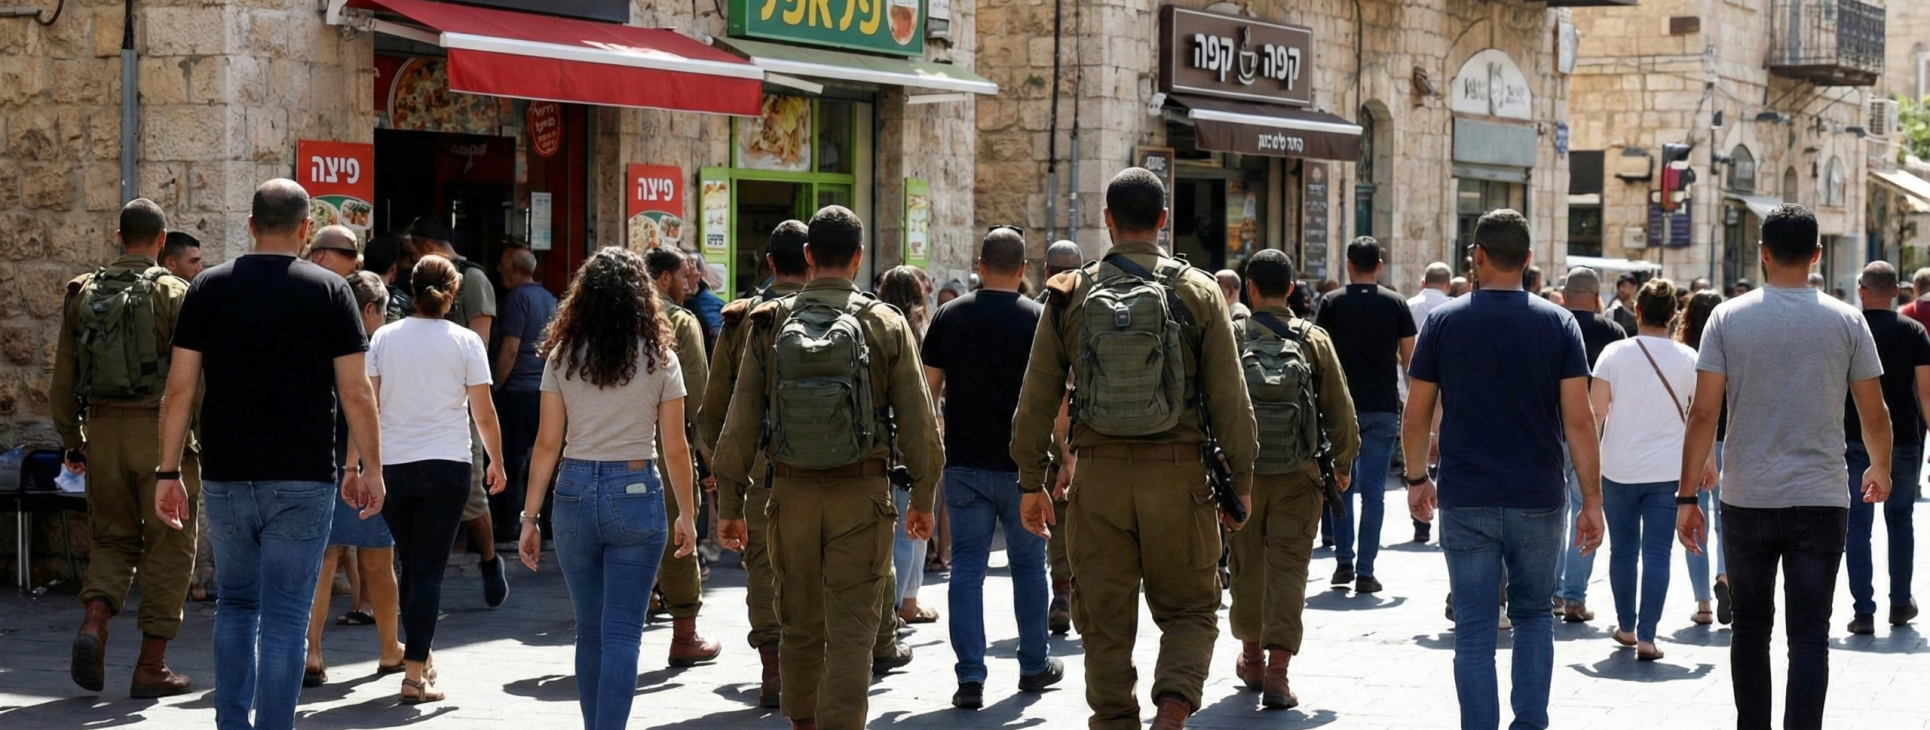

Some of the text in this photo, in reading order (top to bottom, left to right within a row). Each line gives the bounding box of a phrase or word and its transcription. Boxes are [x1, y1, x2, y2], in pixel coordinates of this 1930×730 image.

[1194, 33, 1301, 91] קפה קפה
[311, 155, 360, 184] פיצה
[637, 177, 674, 202] פיצה
